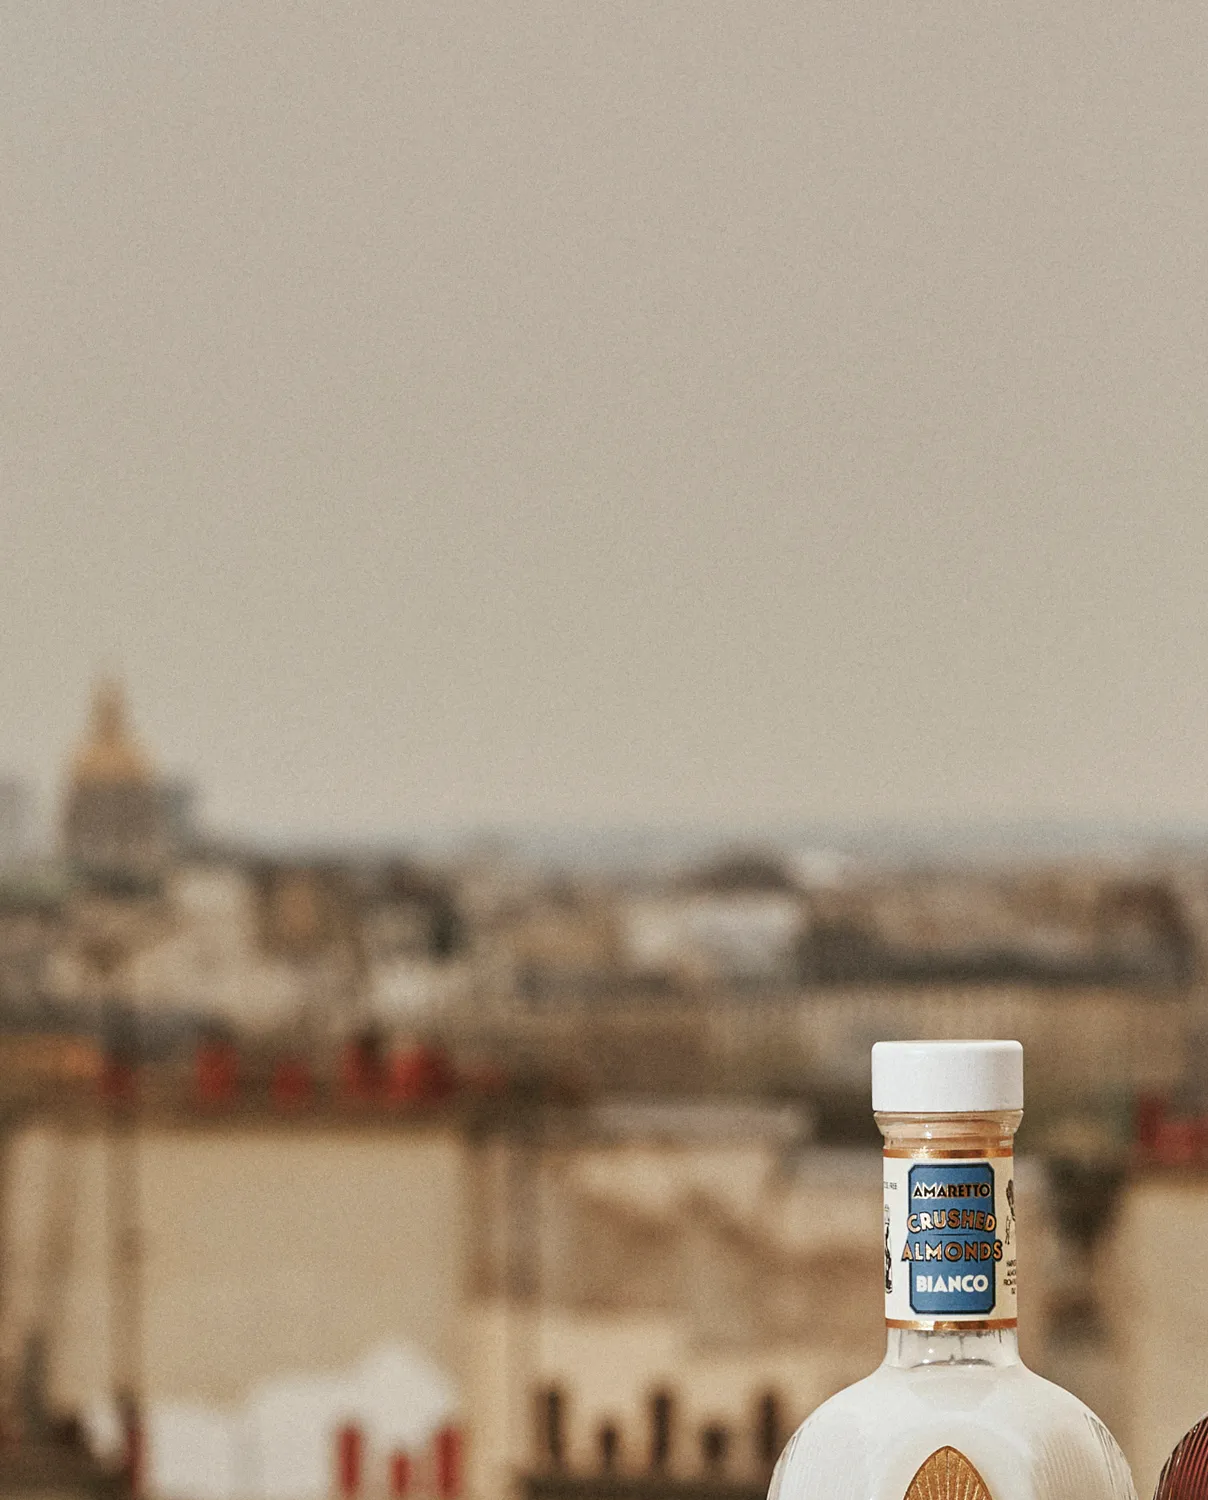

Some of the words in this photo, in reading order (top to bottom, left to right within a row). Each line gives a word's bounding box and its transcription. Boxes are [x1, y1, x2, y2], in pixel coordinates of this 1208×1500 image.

[913, 1182, 991, 1199] AMARETTO
[907, 1208, 997, 1234] CRUSHED
[901, 1239, 1003, 1263] ALMONDS
[916, 1274, 989, 1293] BIANCO
